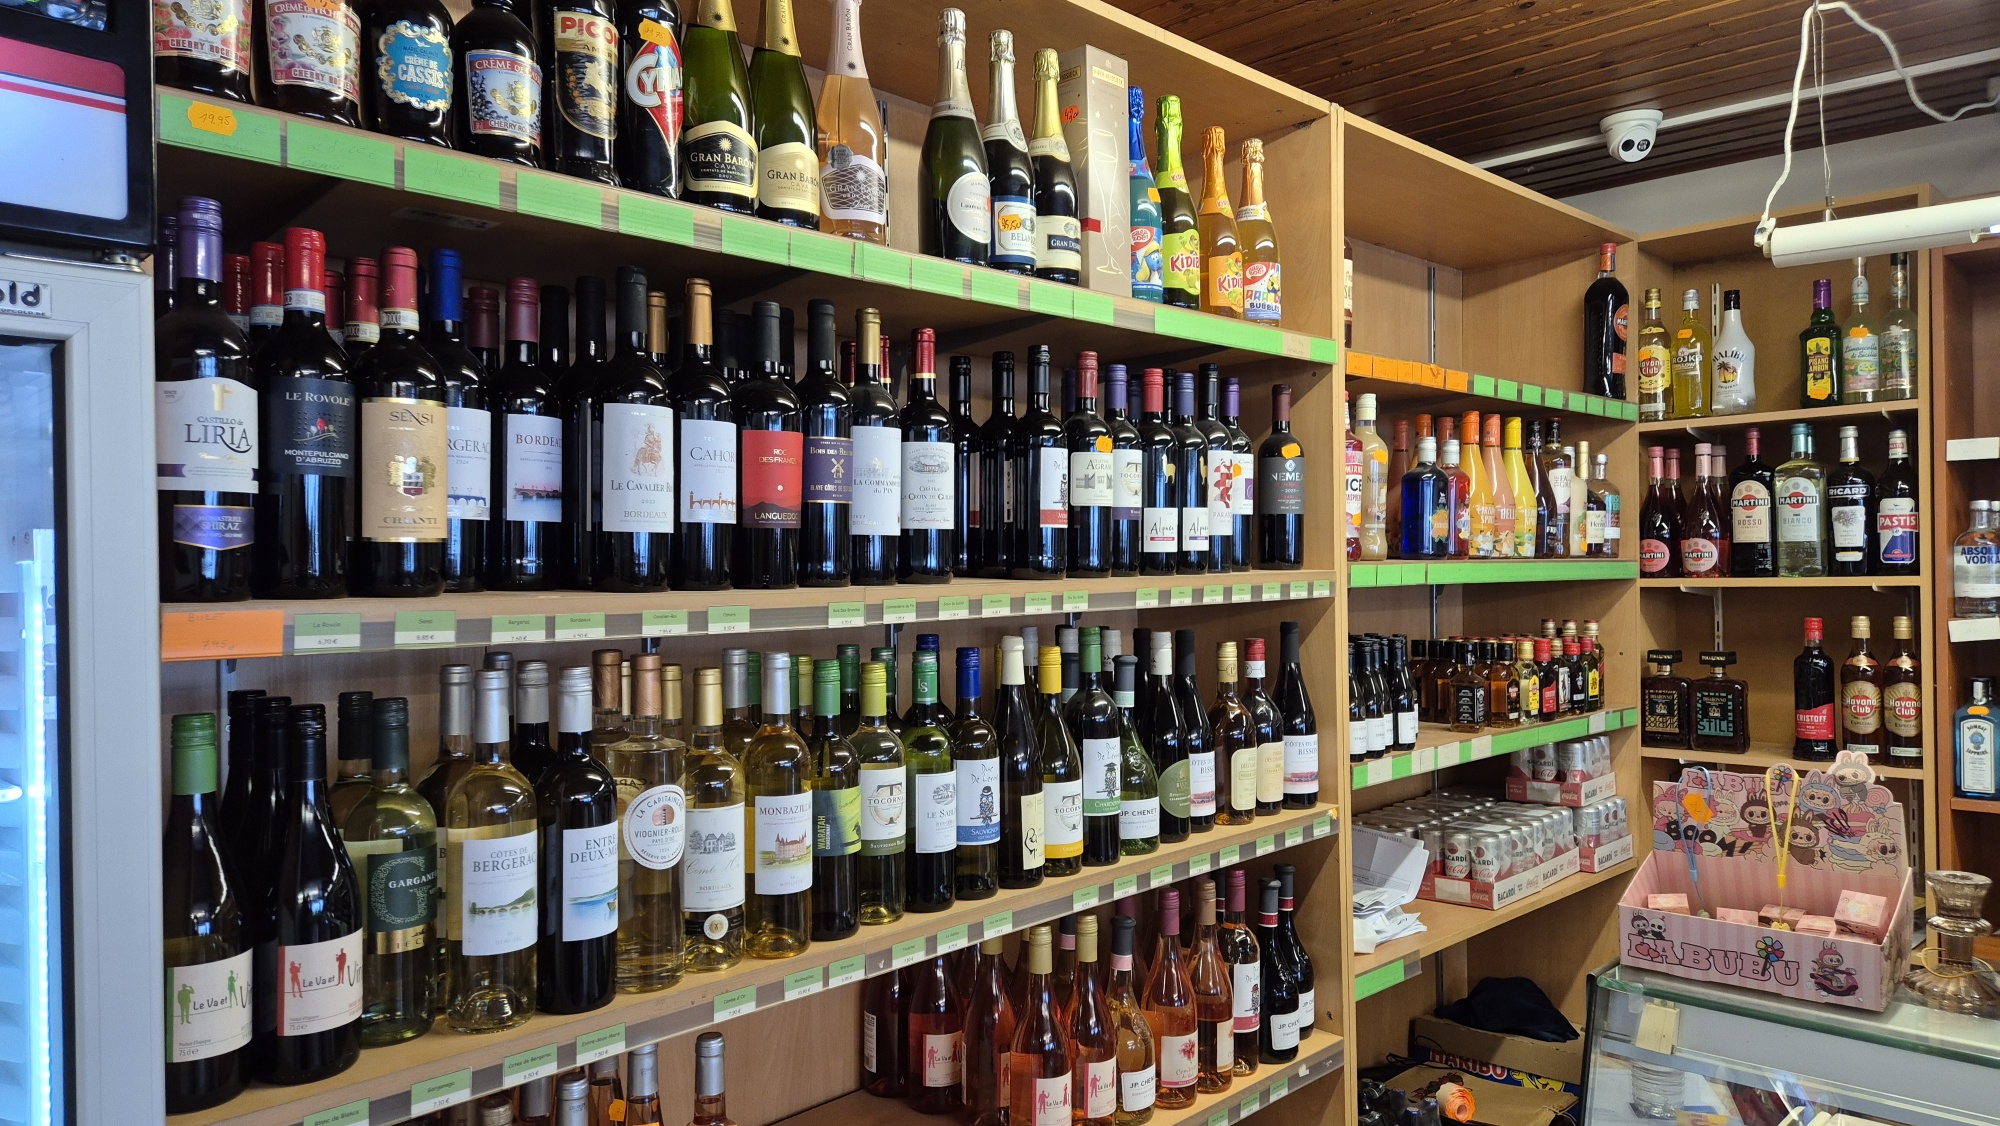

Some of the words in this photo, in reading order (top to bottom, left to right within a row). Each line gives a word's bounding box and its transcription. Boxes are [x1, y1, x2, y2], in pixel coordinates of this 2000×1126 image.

[170, 38, 206, 51] CHERRY
[582, 44, 613, 59] AMR
[405, 55, 428, 67] CRÈME
[475, 59, 511, 71] CRÈME
[293, 68, 326, 82] CHERRY
[398, 64, 444, 89] CASSIS
[489, 120, 518, 132] CHERRY
[690, 153, 722, 166] GRAN
[714, 162, 737, 172] CAVA
[767, 169, 797, 181] GRAN
[1051, 239, 1068, 248] GRAN
[0, 281, 41, 307] ld
[1249, 302, 1280, 314] BUBBLES
[1642, 366, 1658, 376] Club
[285, 391, 301, 401] LE
[305, 392, 350, 407] ROVOLE
[197, 415, 231, 426] CASTILLO
[389, 408, 434, 427] SENSI
[184, 423, 253, 454] LIRIA
[284, 449, 349, 462] MONTEPULCIANO
[296, 456, 341, 466] D'ABRUZZO
[610, 480, 624, 491] LE
[627, 480, 665, 493] CAVALIER
[1828, 486, 1867, 496] RICARD
[1732, 498, 1769, 507] MARTINI
[1779, 495, 1816, 505] MARTINI
[383, 516, 438, 525] CHIANTI
[624, 510, 670, 520] BORDEAUX
[1782, 516, 1812, 525] BIANCO
[1879, 514, 1917, 527] PASTIS
[202, 521, 241, 532] SHIRAZ
[1737, 518, 1763, 526] ROSSO
[1684, 551, 1713, 559] MARTINI
[1847, 697, 1877, 706] Havana
[1890, 699, 1920, 708] Havana
[1851, 705, 1871, 714] Club
[1896, 708, 1916, 717] Club
[1132, 809, 1158, 818] CHENET
[817, 815, 826, 850] WARATAH
[490, 848, 518, 861] CÔTES
[520, 846, 529, 856] DE
[1497, 885, 1516, 902] BACARDÍ
[1627, 933, 1800, 988] LABUBU
[302, 978, 314, 988] Le
[315, 972, 327, 985] Va
[193, 1001, 206, 1011] Le
[207, 997, 219, 1008] Va
